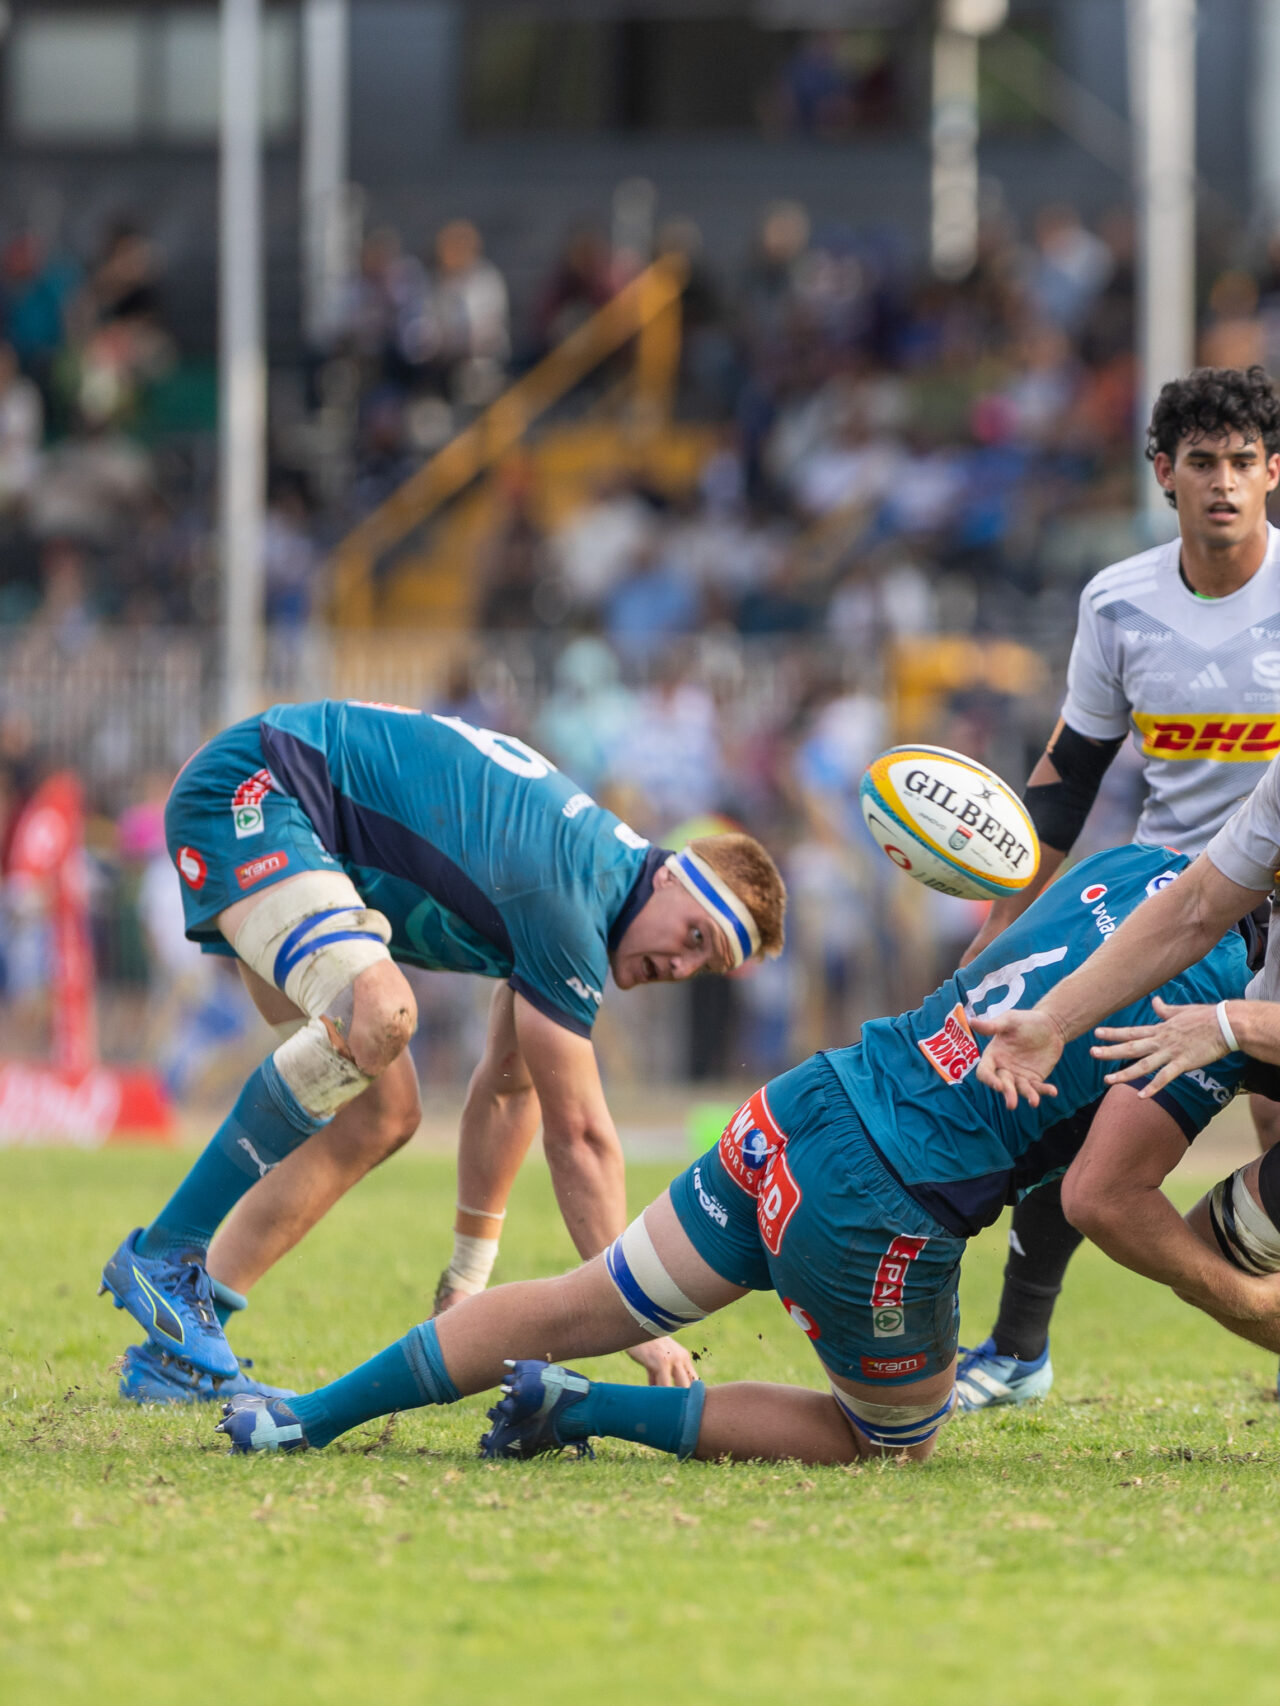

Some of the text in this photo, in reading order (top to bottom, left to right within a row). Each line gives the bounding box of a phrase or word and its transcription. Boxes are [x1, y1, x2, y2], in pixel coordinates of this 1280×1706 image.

[905, 769, 1030, 869] GILBERT
[966, 945, 1069, 1020] 6
[924, 1032, 968, 1080] KING
[944, 1016, 981, 1065] BURGER
[878, 1358, 917, 1372] ram
